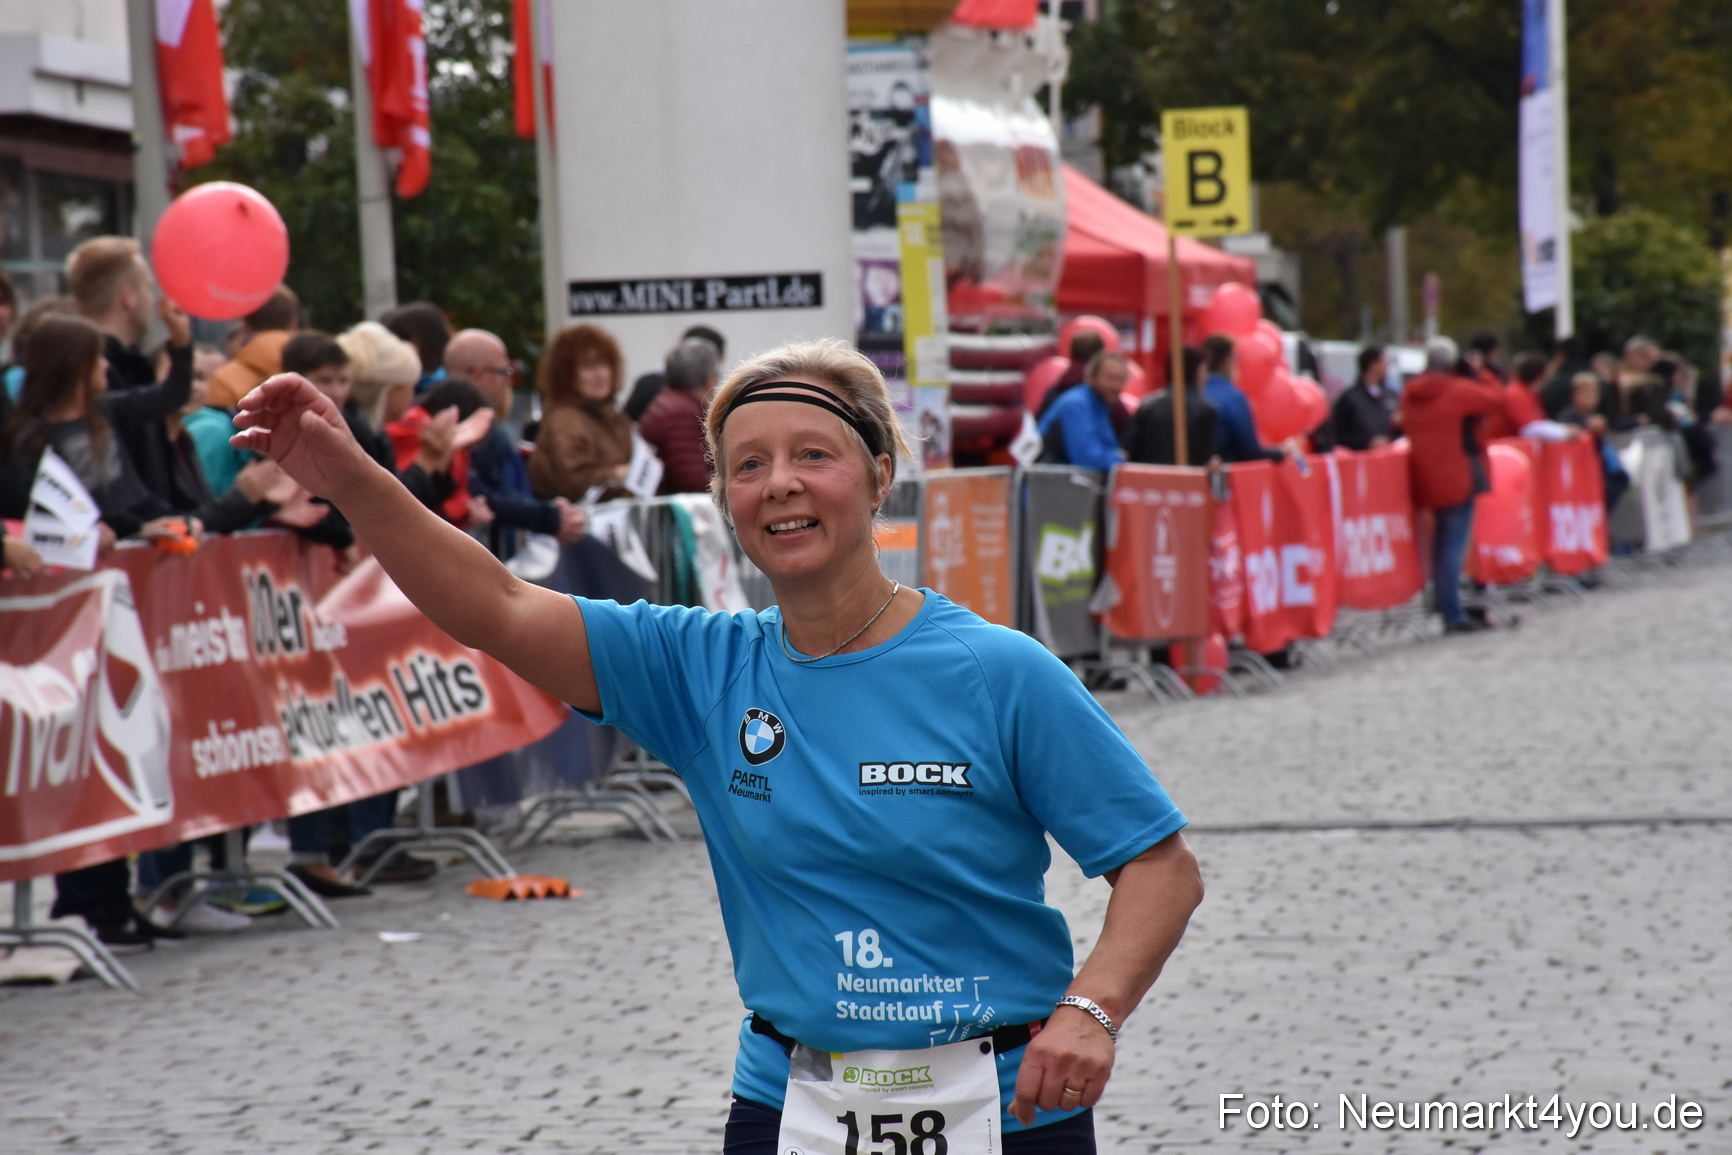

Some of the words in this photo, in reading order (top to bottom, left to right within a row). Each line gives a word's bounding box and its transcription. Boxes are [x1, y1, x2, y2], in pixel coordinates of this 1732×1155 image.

[1172, 116, 1236, 140] Block
[1187, 149, 1227, 208] B
[393, 653, 486, 730] Hits
[744, 711, 784, 735] BMW
[731, 769, 772, 792] PARTL
[861, 763, 968, 785] BOCK
[728, 783, 772, 803] Neumarkt
[859, 787, 893, 796] inspired
[895, 787, 906, 796] by
[908, 788, 934, 796] smart
[935, 789, 974, 798] concepts
[834, 928, 893, 969] 18.
[837, 973, 964, 994] Neumarkter
[836, 1000, 943, 1024] Stadtlauf
[862, 1066, 932, 1086] BOCK
[858, 1085, 881, 1093] inspired
[881, 1085, 890, 1094] by
[908, 1082, 935, 1091] concepts
[836, 1110, 949, 1155] 158
